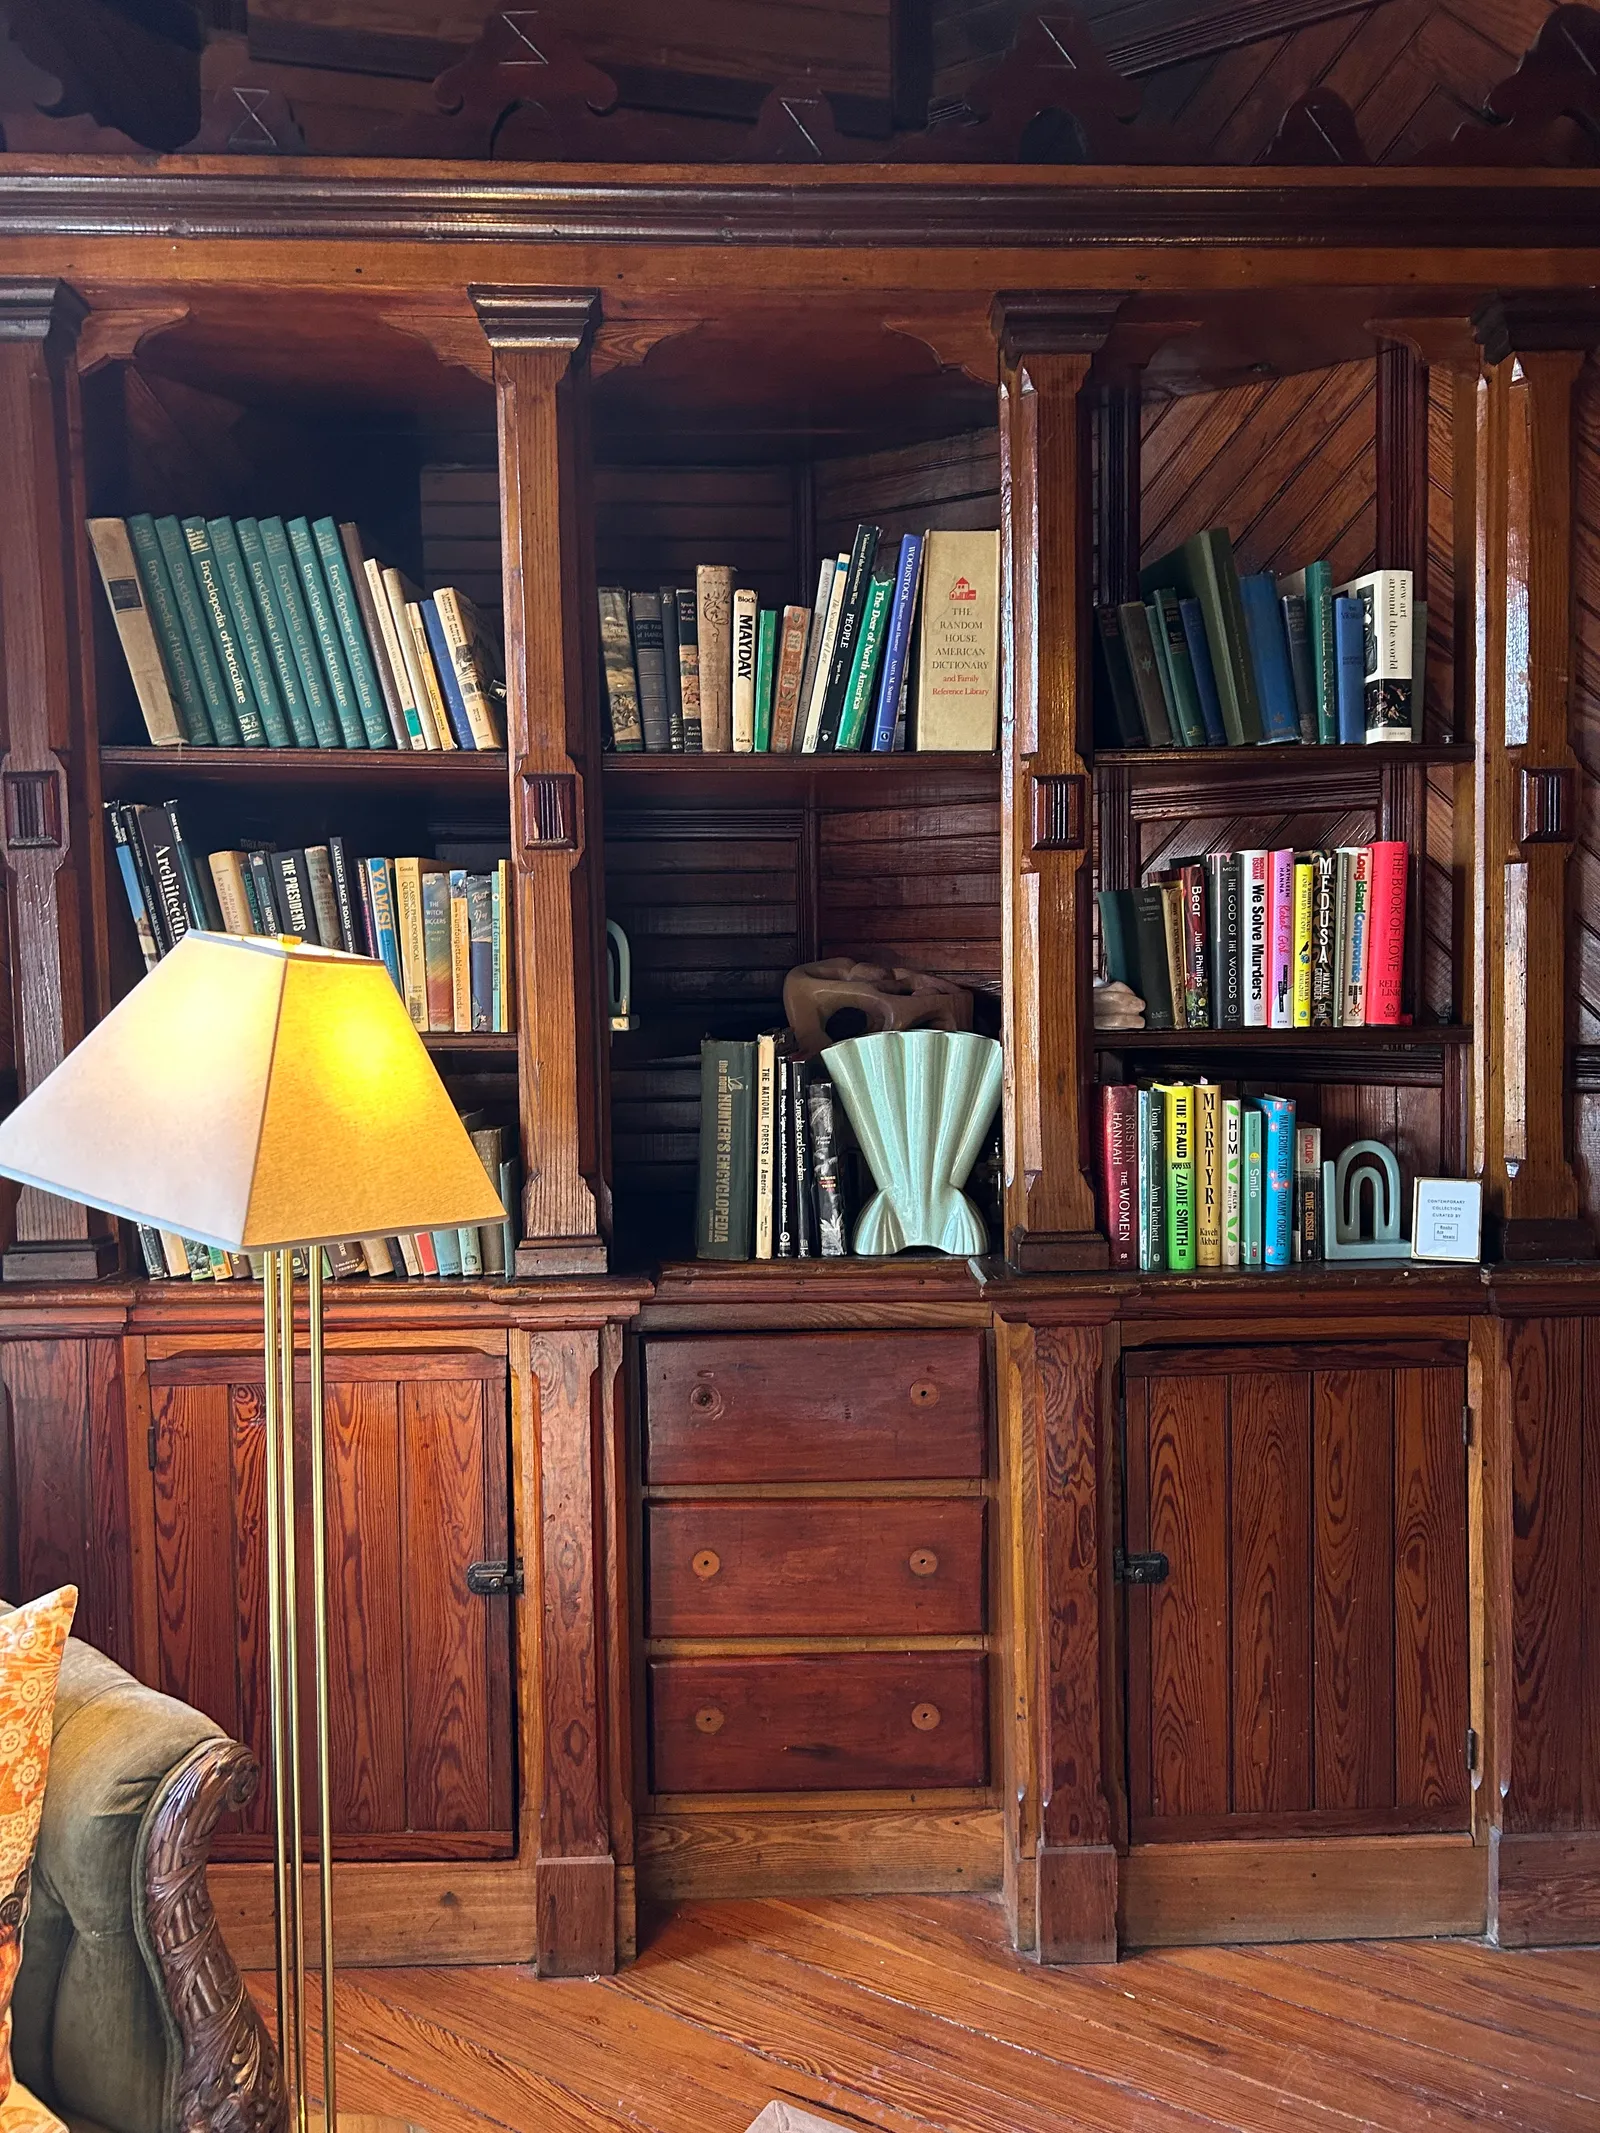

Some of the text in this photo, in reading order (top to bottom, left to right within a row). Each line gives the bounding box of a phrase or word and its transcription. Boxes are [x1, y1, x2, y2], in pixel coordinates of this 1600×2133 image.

[850, 533, 871, 605] Visions American West
[303, 563, 328, 632] Encyclopedia
[737, 595, 756, 603] Block
[951, 607, 972, 616] THE
[1399, 602, 1407, 619] art
[200, 560, 246, 704] Encyclopedia of Horticulture
[227, 562, 271, 706] Encyclopedia Horticulture
[252, 561, 296, 705] Encyclopedia of Horticulture
[278, 564, 302, 632] Encyclopedia
[300, 647, 321, 707] Horticulture
[322, 633, 334, 645] of
[329, 564, 372, 708] Encyclopedia of Horticulture
[738, 614, 753, 681] MAYDAY
[840, 612, 855, 649] PEOPLE
[886, 545, 916, 703] WOODSTOCK History ANITA SMITH
[940, 621, 983, 630] RANDOM
[945, 634, 978, 643] HOUSE
[1388, 578, 1399, 671] around the world
[852, 591, 885, 710] The Deer of North America
[932, 661, 989, 670] DICTIONARY
[935, 648, 986, 656] AMERICAN
[326, 647, 348, 707] Horticulture
[932, 687, 989, 697] Reference Library
[943, 674, 980, 684] and Family
[170, 812, 183, 842] max ernst
[244, 873, 257, 909] ELEMENTS
[333, 844, 351, 930] AMERICA'S BACK ROADS
[1251, 857, 1259, 881] OSMAN
[1353, 852, 1368, 881] Long
[228, 890, 241, 929] ORIGINAL
[281, 857, 307, 932] THE PRESIDENTS
[371, 868, 392, 931] YAMSI
[401, 881, 410, 920] QUESTIONS
[1278, 904, 1290, 931] Rebel
[1319, 856, 1333, 964] MEDUSA
[1354, 881, 1368, 913] Island
[1387, 851, 1404, 972] THE BOOK OF LOVE
[409, 881, 421, 961] CLASSIC PHILOSOPHICAL
[454, 918, 463, 971] unforgettable
[1191, 886, 1204, 988] Bear Julia Phillips
[1227, 878, 1238, 1000] THE GOD OF THE WOODS
[1251, 883, 1265, 1001] We Solve Murders
[1278, 935, 1288, 957] Girl
[1351, 913, 1366, 983] Compromise
[493, 967, 501, 991] Nursing
[1314, 967, 1323, 1001] GRUENDER
[1322, 972, 1331, 996] NATALY
[1381, 988, 1401, 997] LINK
[760, 1068, 770, 1195] THE NATIONAL FORESTS of America
[795, 1099, 805, 1131] Surrealists
[796, 1132, 805, 1147] and
[1112, 1112, 1123, 1165] HANNAH
[1125, 1114, 1136, 1164] KRISTIN
[1227, 1119, 1239, 1155] HUM
[714, 1060, 732, 1243] the new HUNTER'S ENCYCLOPEDIA
[797, 1147, 806, 1181] Surrealism
[1151, 1105, 1162, 1242] Tom Lake Ann Patchett
[1175, 1097, 1189, 1247] THE FRAUD ZADIE SMITH
[1203, 1092, 1216, 1224] MARTYR!
[1304, 1134, 1314, 1165] CYCLOPS
[1118, 1170, 1131, 1242] THE WOMEN
[1249, 1168, 1260, 1199] Smile
[1276, 1114, 1289, 1248] WANDERING STARS TOMMY ORANGE
[1199, 1227, 1218, 1236] Kaveh
[1200, 1236, 1219, 1246] Akbar
[1304, 1191, 1315, 1241] CLIVE CUSSLER
